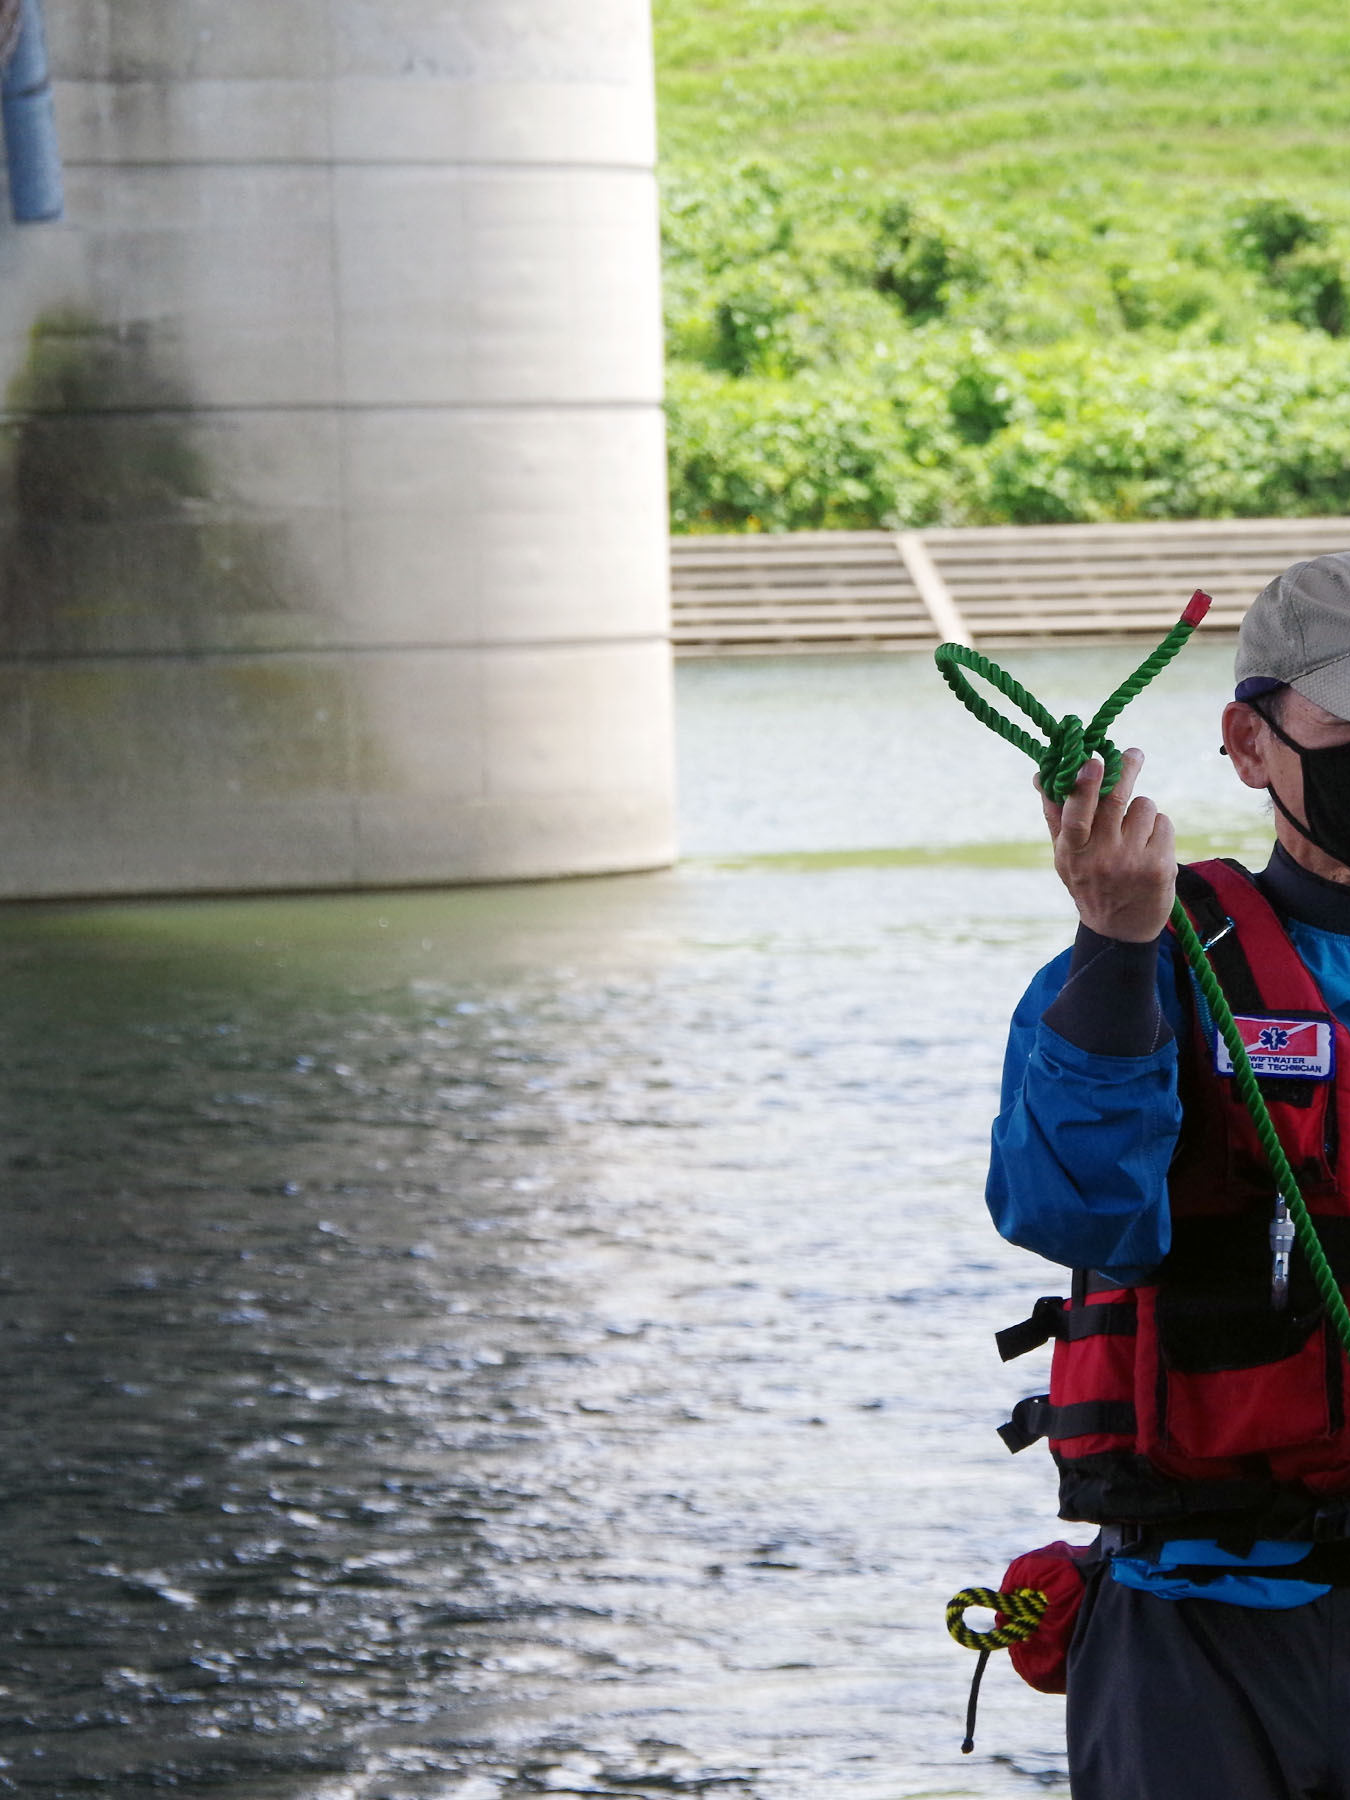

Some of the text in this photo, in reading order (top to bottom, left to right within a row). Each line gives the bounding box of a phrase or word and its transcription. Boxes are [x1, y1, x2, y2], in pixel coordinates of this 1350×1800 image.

[1248, 1055, 1305, 1064] WIFTWATER
[1226, 1062, 1322, 1073] RUE TECHNICIAN
